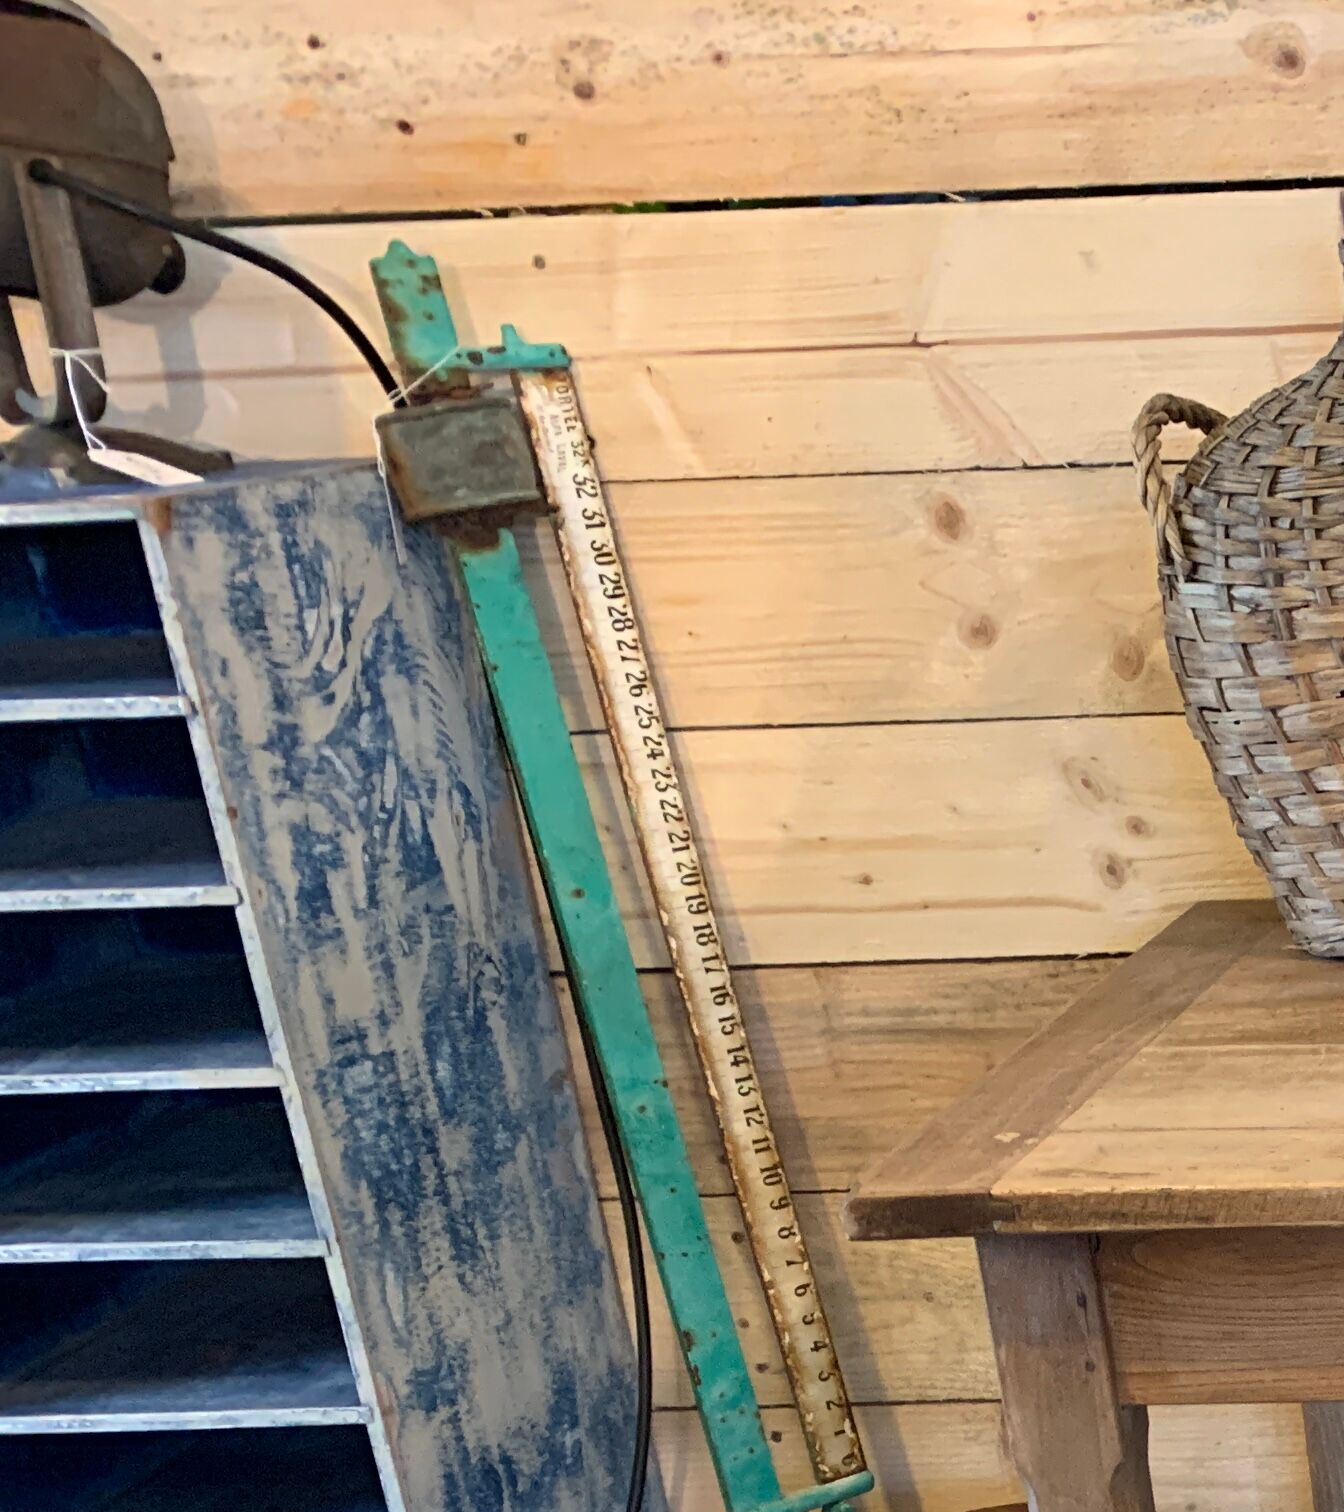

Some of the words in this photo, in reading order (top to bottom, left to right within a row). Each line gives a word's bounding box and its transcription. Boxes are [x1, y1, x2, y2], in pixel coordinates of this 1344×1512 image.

[572, 473, 599, 499] 32
[582, 507, 607, 530] 31
[590, 539, 617, 566] 30
[598, 572, 627, 600] 29
[607, 603, 636, 633] 28
[616, 638, 643, 662] 27
[625, 670, 649, 698] 26
[634, 702, 661, 730] 25
[642, 733, 666, 761] 24
[651, 766, 680, 793] 23
[659, 796, 685, 823] 22
[668, 829, 691, 853] 21
[676, 858, 701, 887] 20
[685, 892, 709, 915] 19
[692, 921, 718, 947] 18
[701, 951, 726, 975] 17
[709, 984, 734, 1007] 16
[718, 1014, 740, 1036] 15
[727, 1044, 750, 1068] 14
[743, 1103, 766, 1128] 12
[751, 1134, 773, 1155] 11
[760, 1163, 784, 1187] 10
[769, 1195, 792, 1211] 9
[777, 1224, 797, 1240] 8
[794, 1282, 815, 1298] 6
[810, 1340, 829, 1353] 4
[825, 1397, 845, 1411] 2
